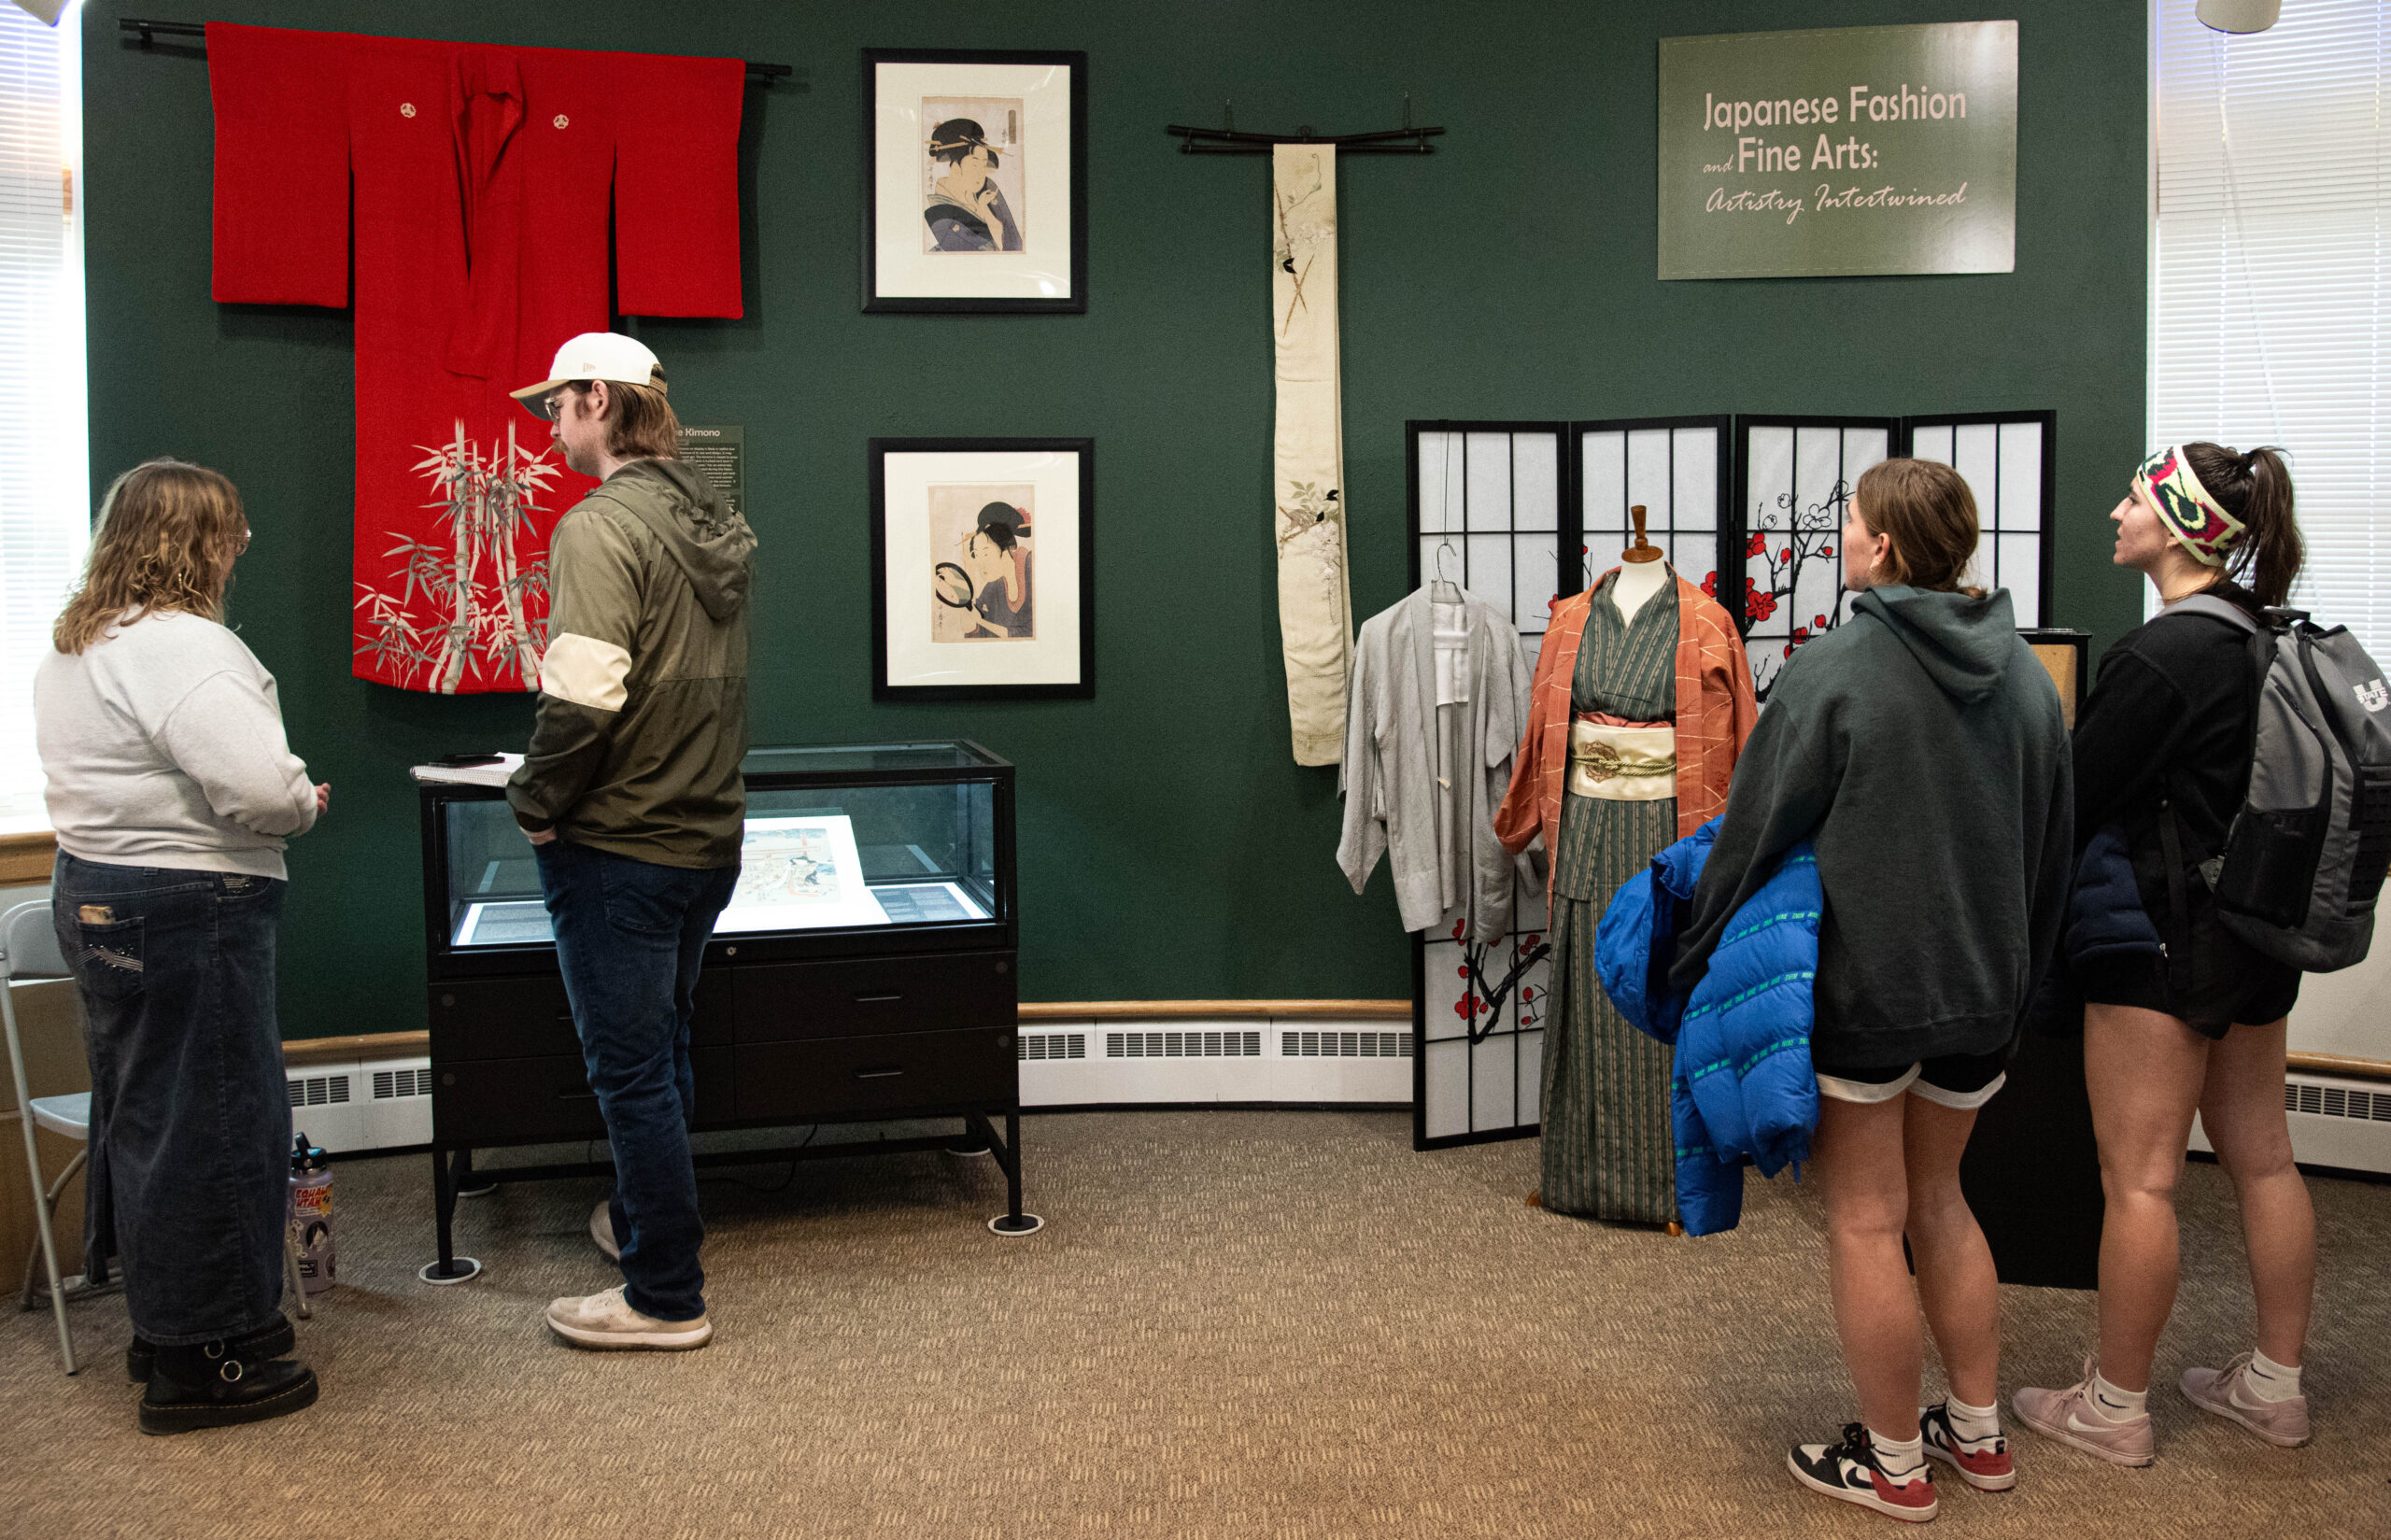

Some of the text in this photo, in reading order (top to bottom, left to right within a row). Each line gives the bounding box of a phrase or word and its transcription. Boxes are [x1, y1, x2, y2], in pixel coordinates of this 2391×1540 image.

[1704, 83, 1966, 134] Japanese Fashion
[1704, 134, 1878, 173] and Fine Arts:
[1705, 181, 1968, 224] Artistry Intertwined
[685, 428, 720, 437] Kimono
[2356, 687, 2389, 704] STATE
[296, 1196, 321, 1208] UTAH
